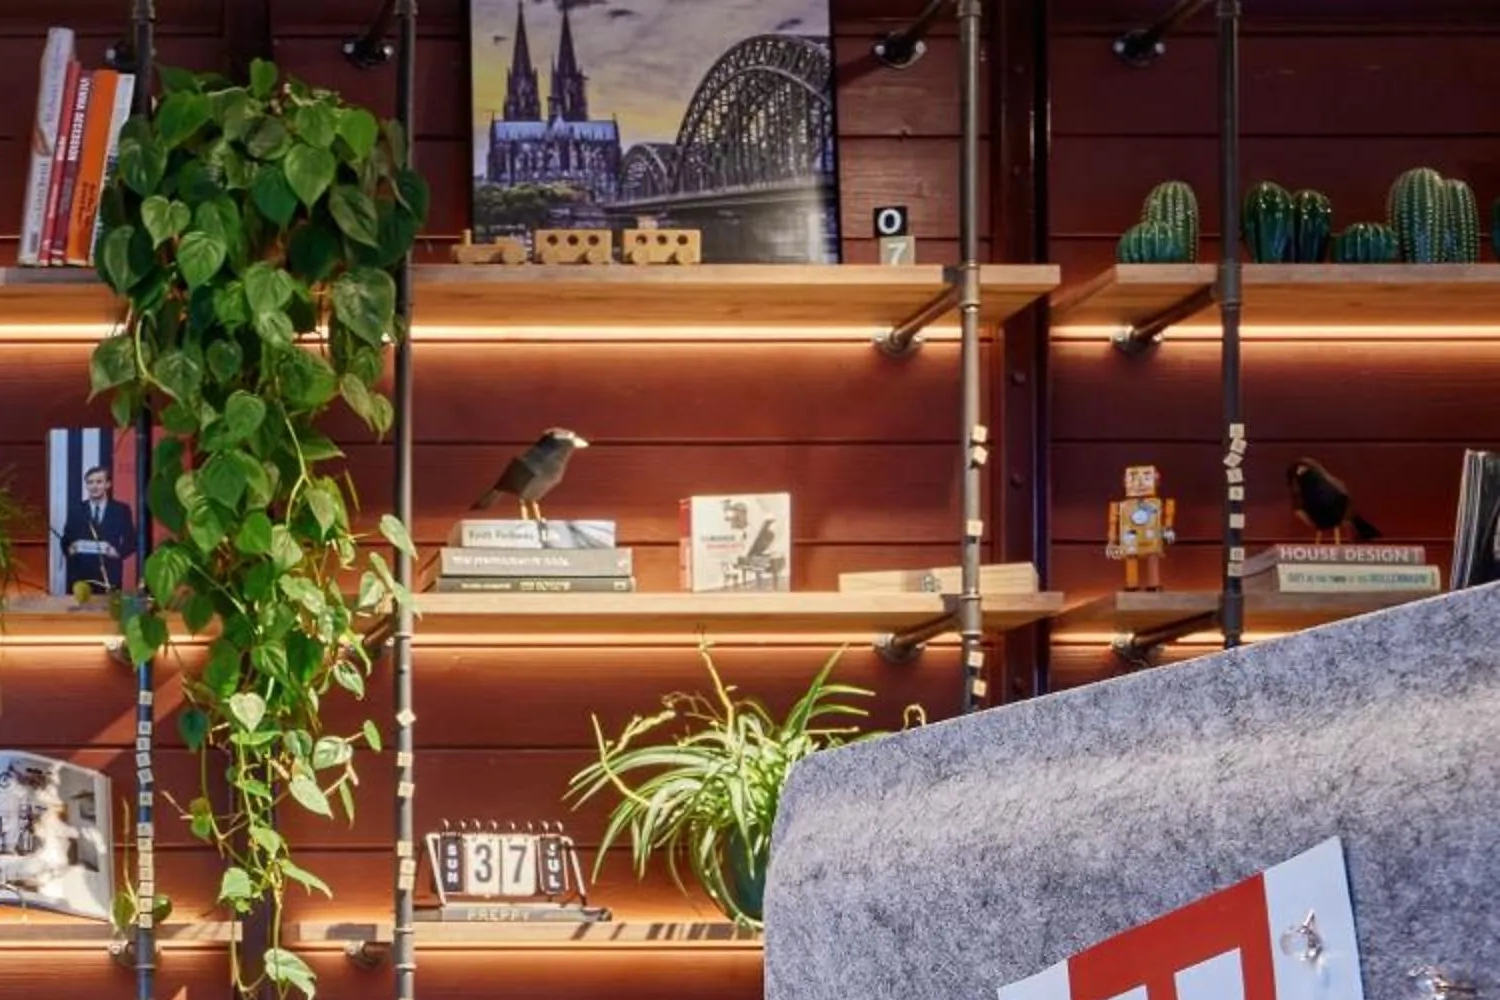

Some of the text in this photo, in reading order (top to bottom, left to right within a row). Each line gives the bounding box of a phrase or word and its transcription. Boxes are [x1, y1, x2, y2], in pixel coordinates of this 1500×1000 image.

[887, 242, 906, 265] 7
[1280, 547, 1409, 562] HOUSE DESIGN
